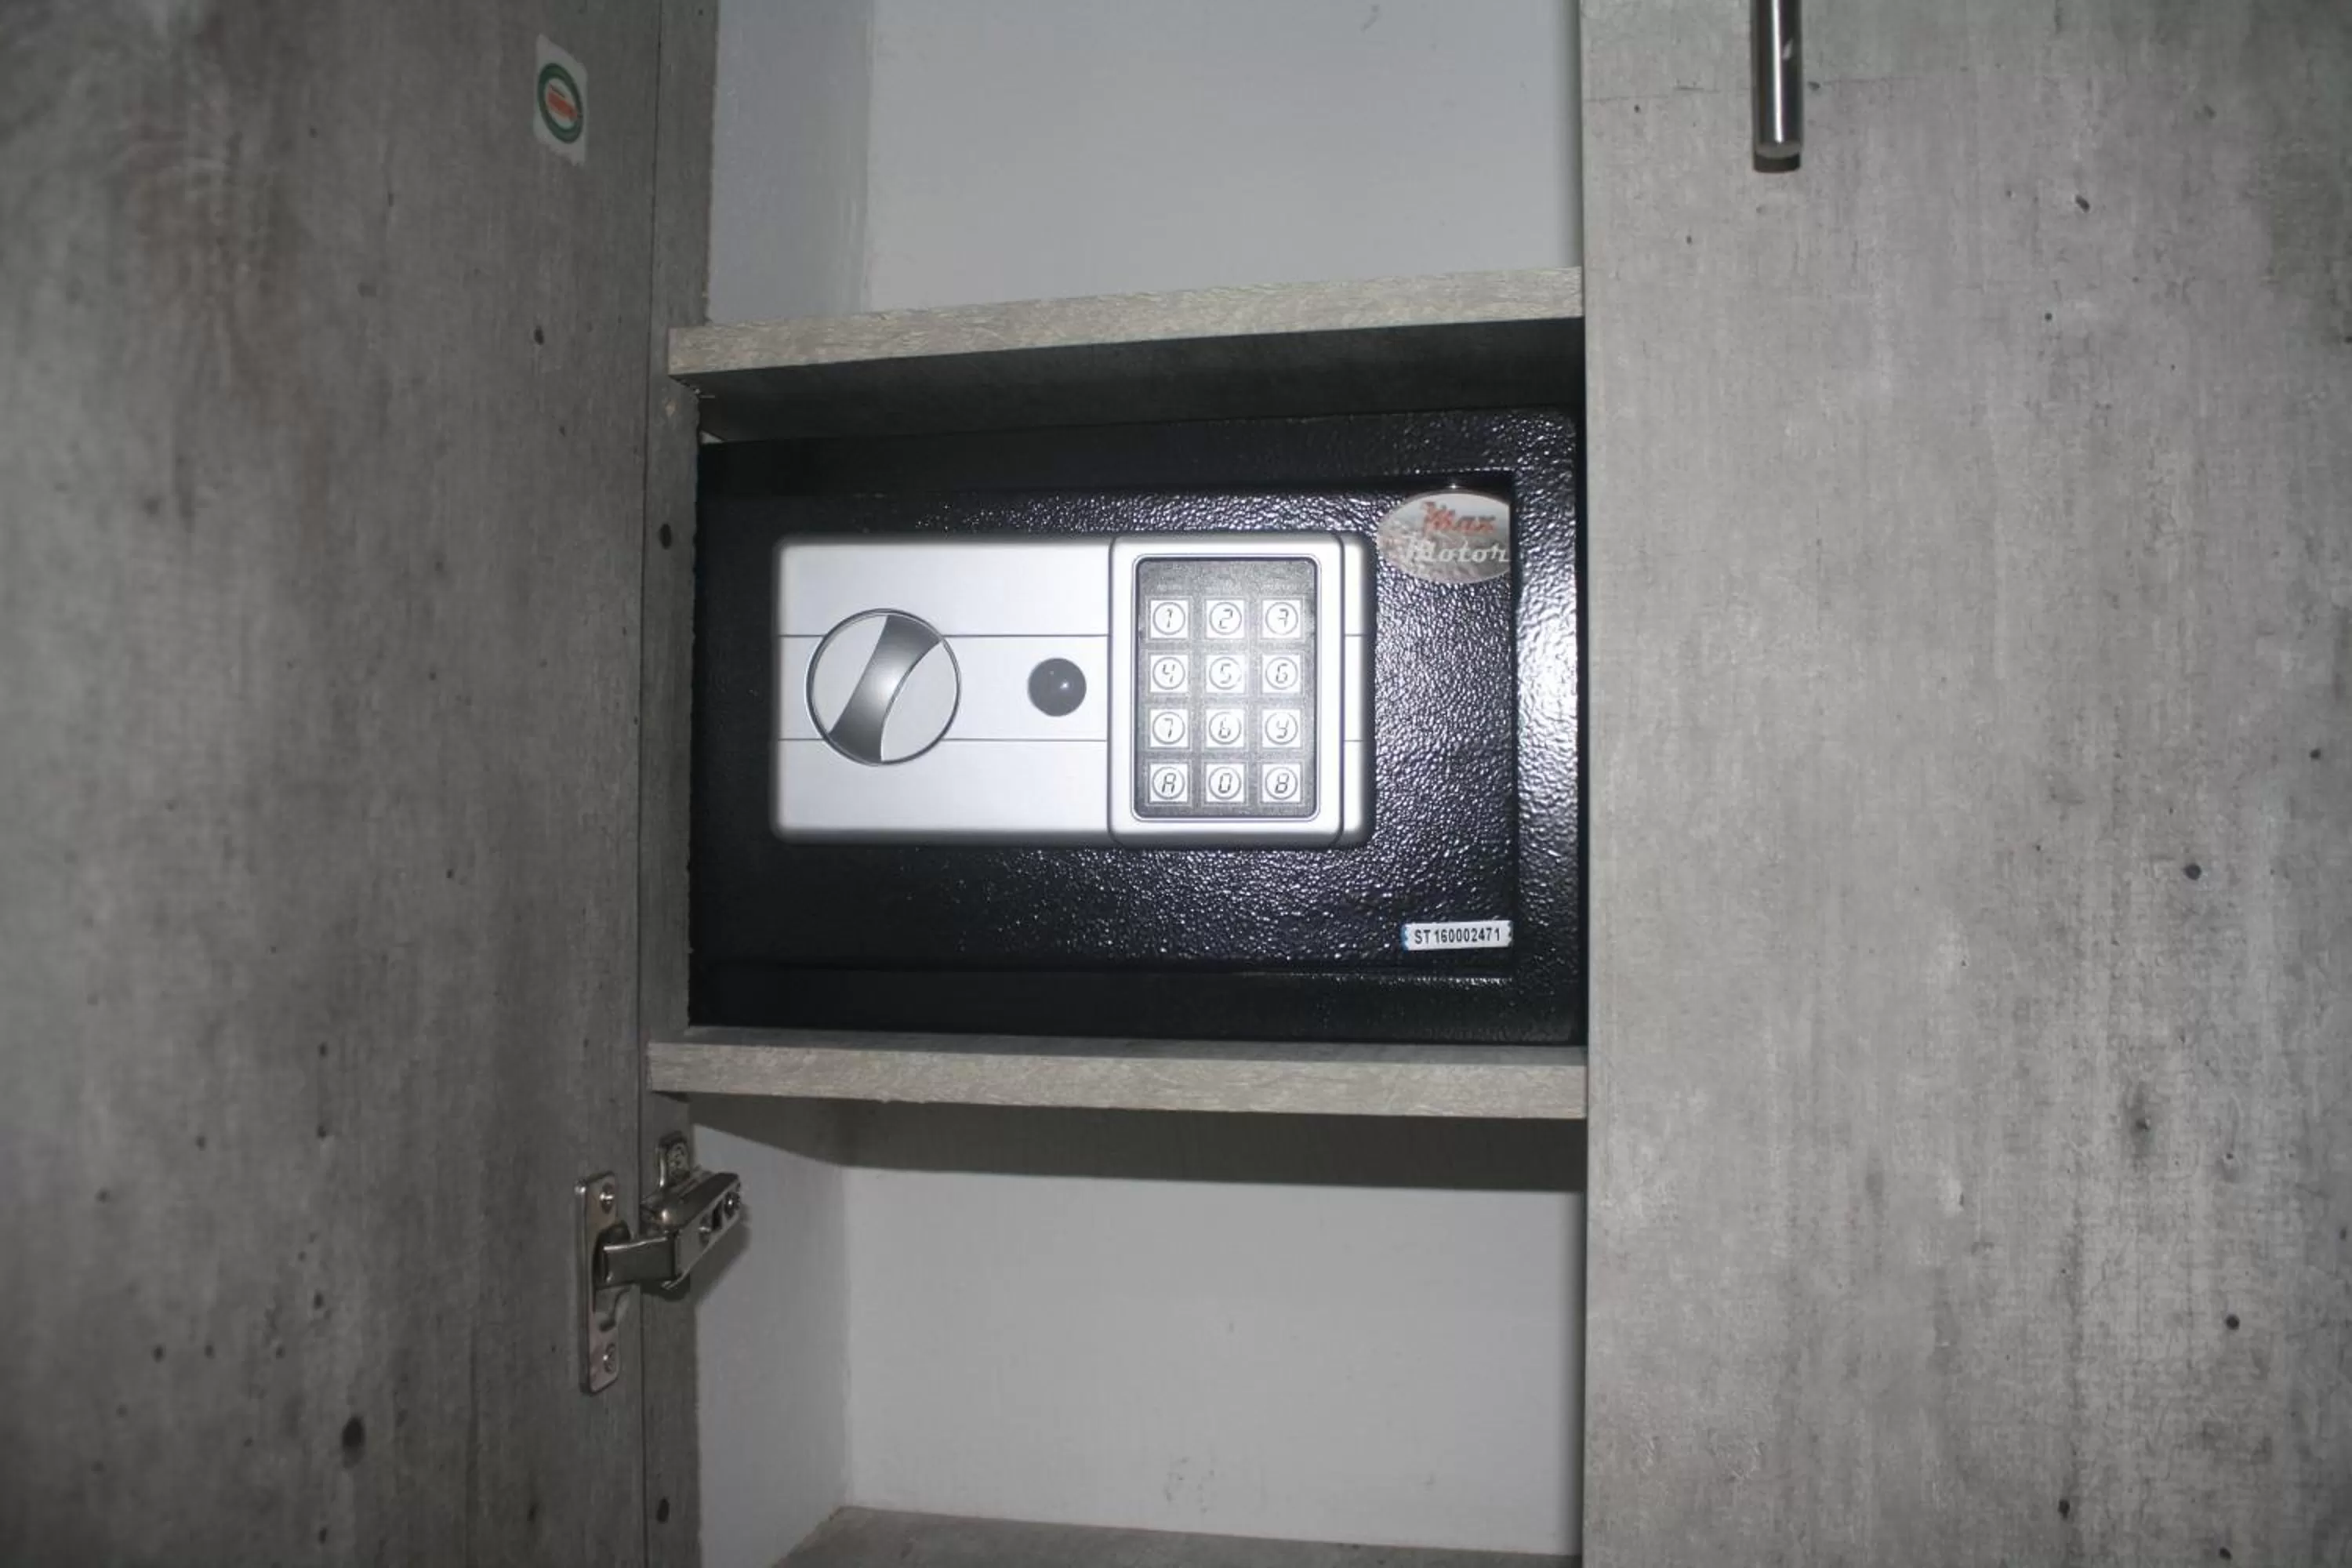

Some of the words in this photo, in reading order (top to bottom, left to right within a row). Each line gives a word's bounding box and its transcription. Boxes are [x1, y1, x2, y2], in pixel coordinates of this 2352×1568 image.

[1218, 607, 1233, 629] 2
[1162, 663, 1176, 684] 4
[1219, 662, 1232, 684] 5
[1276, 662, 1289, 684] 6
